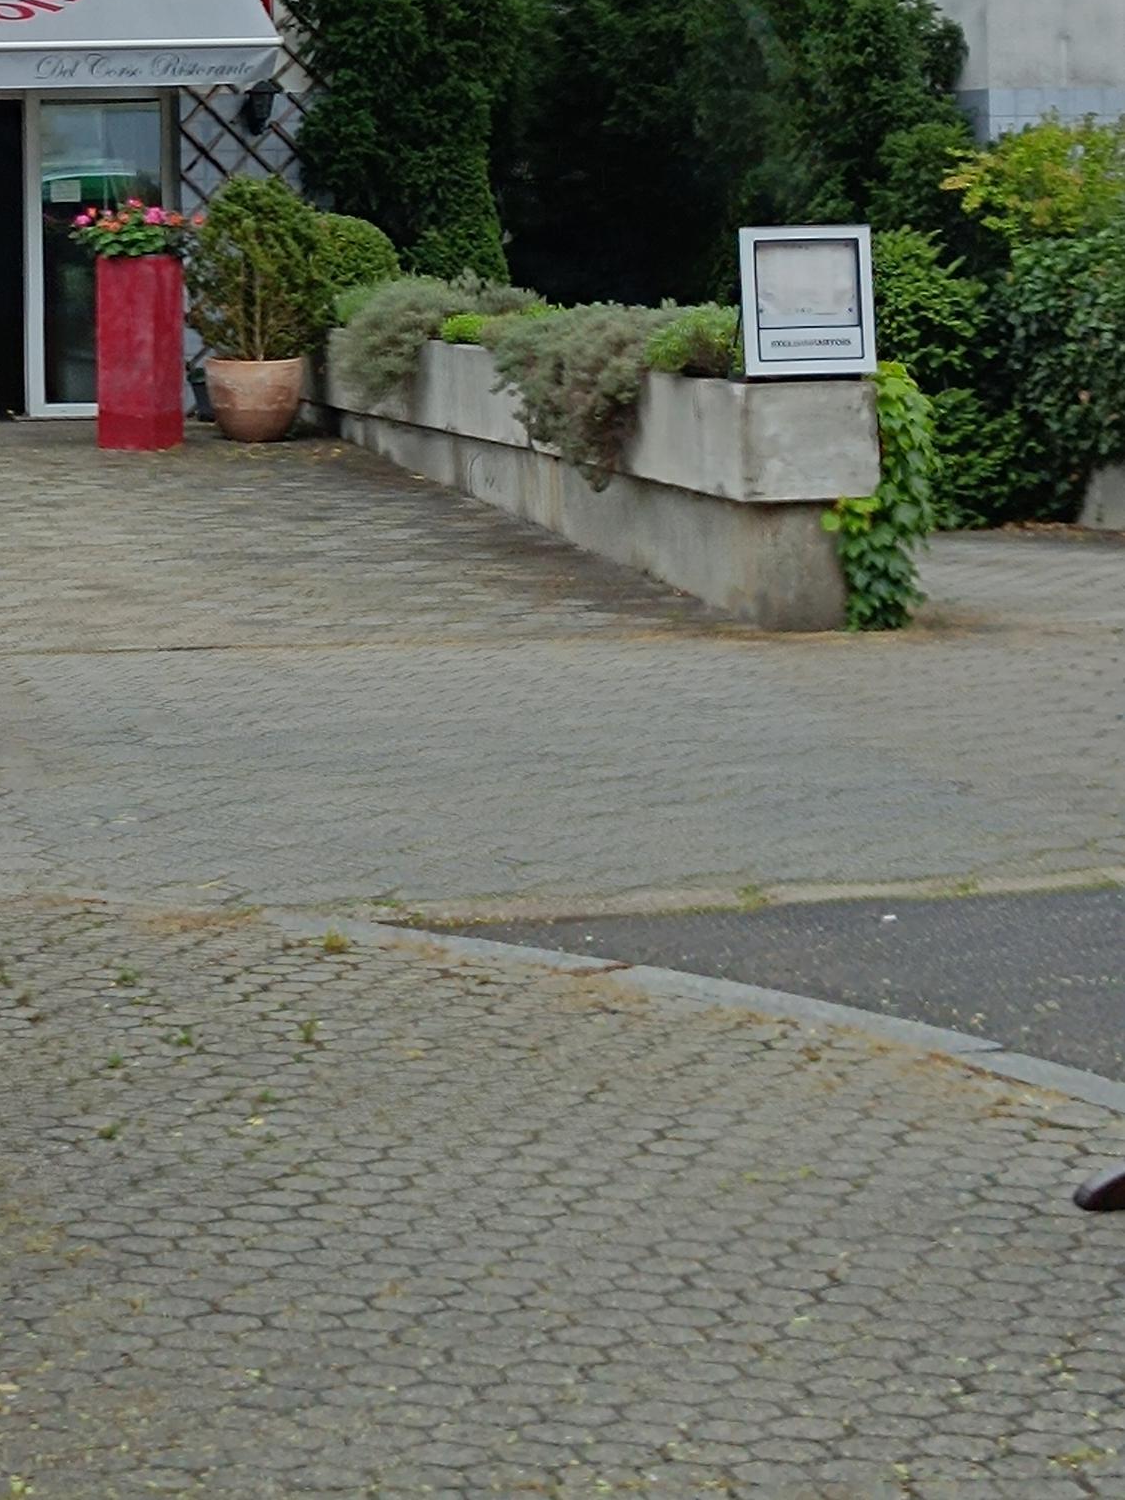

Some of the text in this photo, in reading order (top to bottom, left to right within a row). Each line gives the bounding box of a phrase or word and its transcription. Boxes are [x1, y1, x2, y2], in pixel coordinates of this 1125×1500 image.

[34, 52, 256, 79] Del Corso Ristorante
